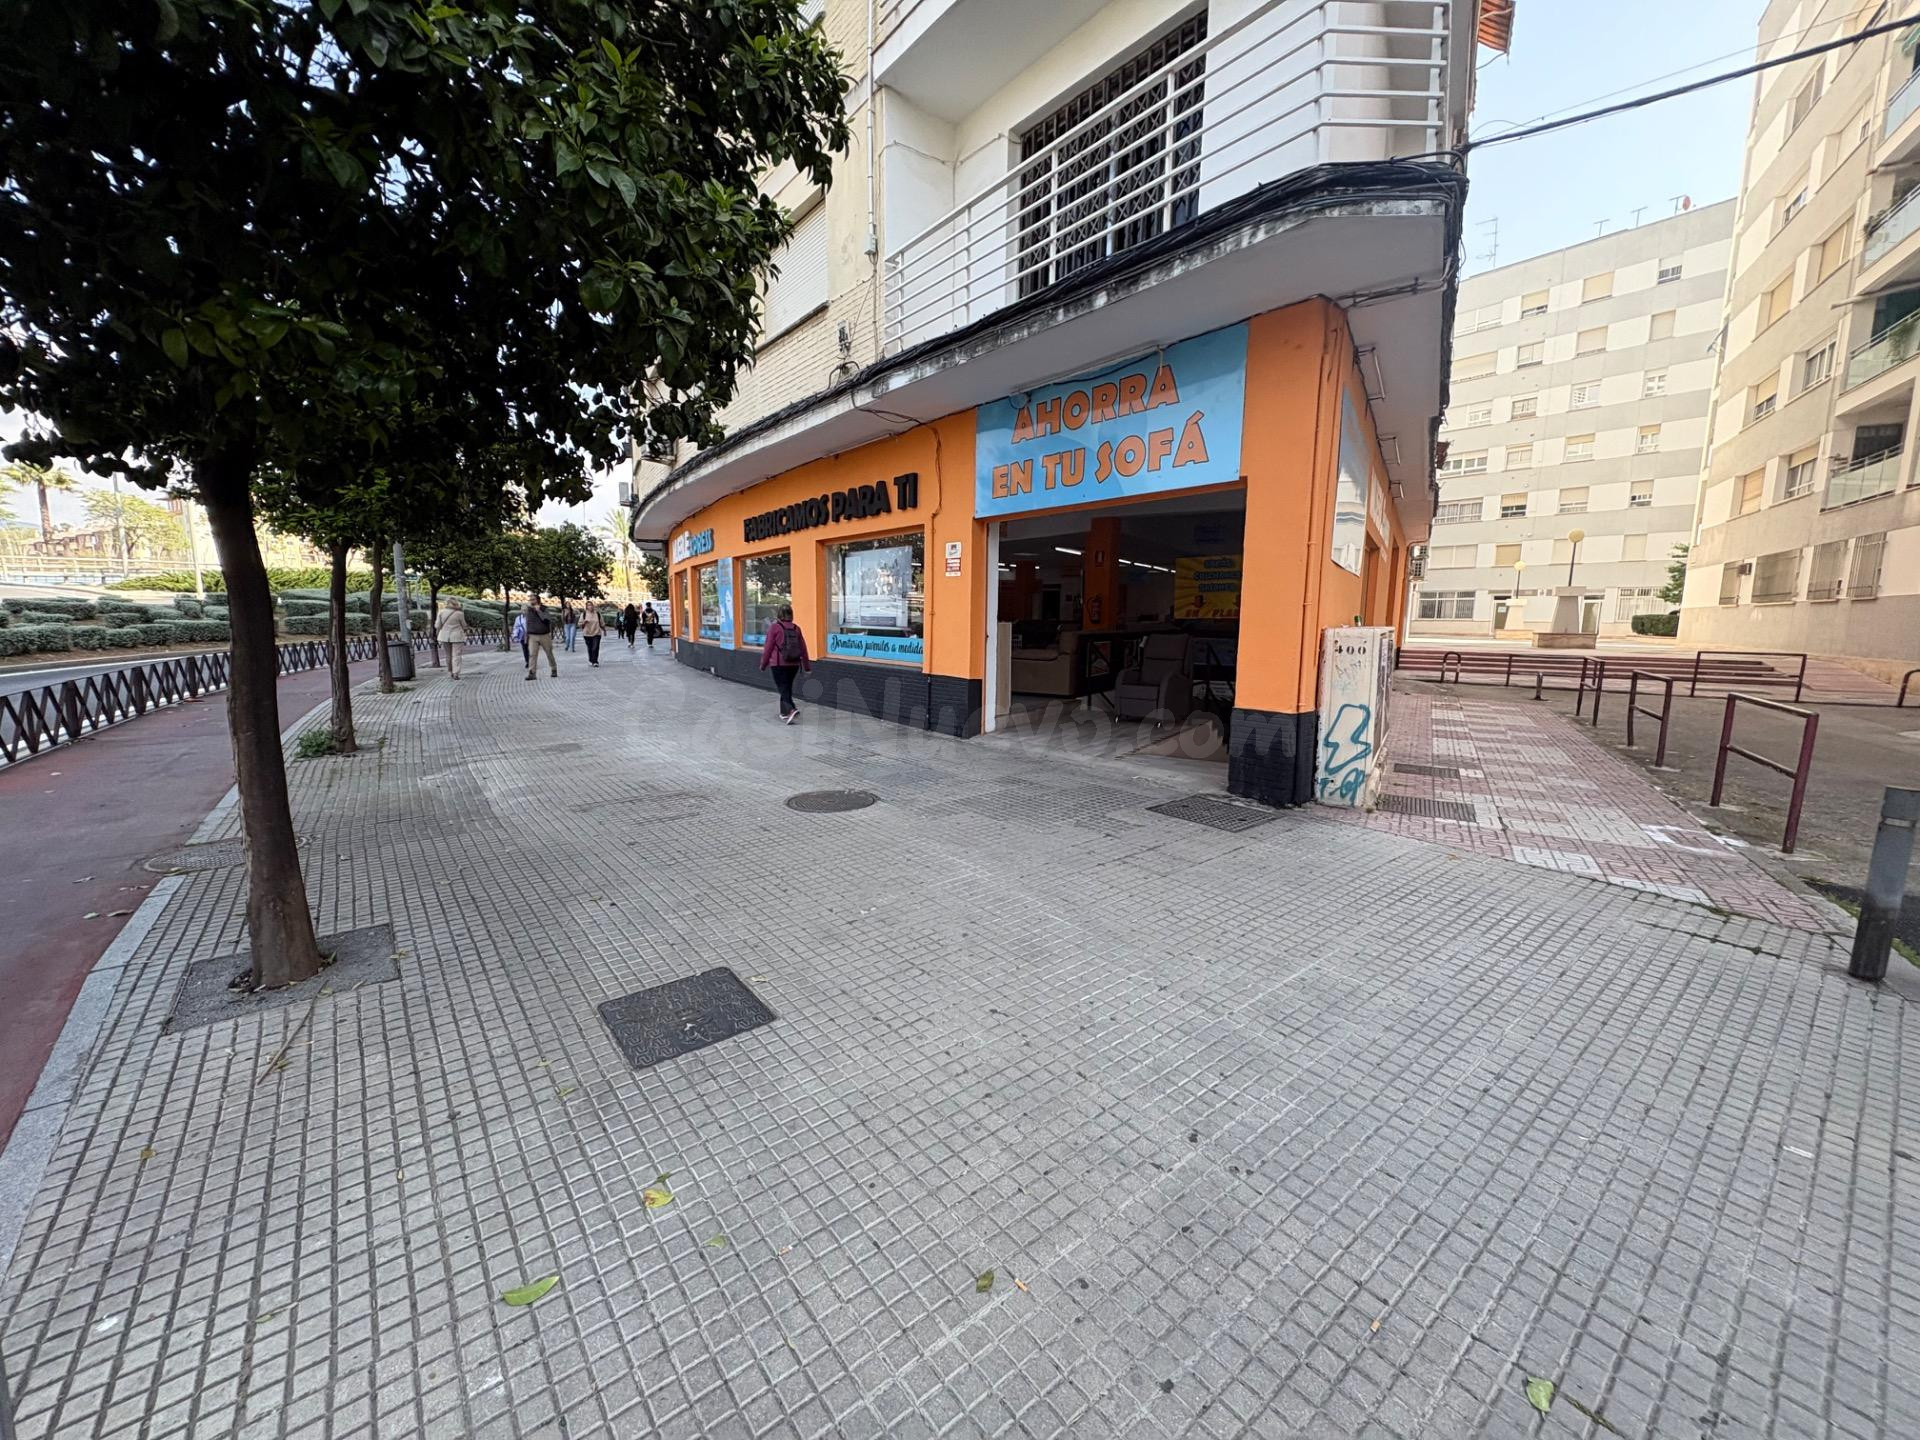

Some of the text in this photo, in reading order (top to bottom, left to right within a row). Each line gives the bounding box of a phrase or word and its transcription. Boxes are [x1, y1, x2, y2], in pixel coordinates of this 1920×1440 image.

[1011, 364, 1180, 444] AHORRA
[992, 410, 1209, 499] EN TU SOFÁ
[743, 472, 919, 543] FABRICAMOS PARA TI
[831, 635, 863, 651] Dormitorios
